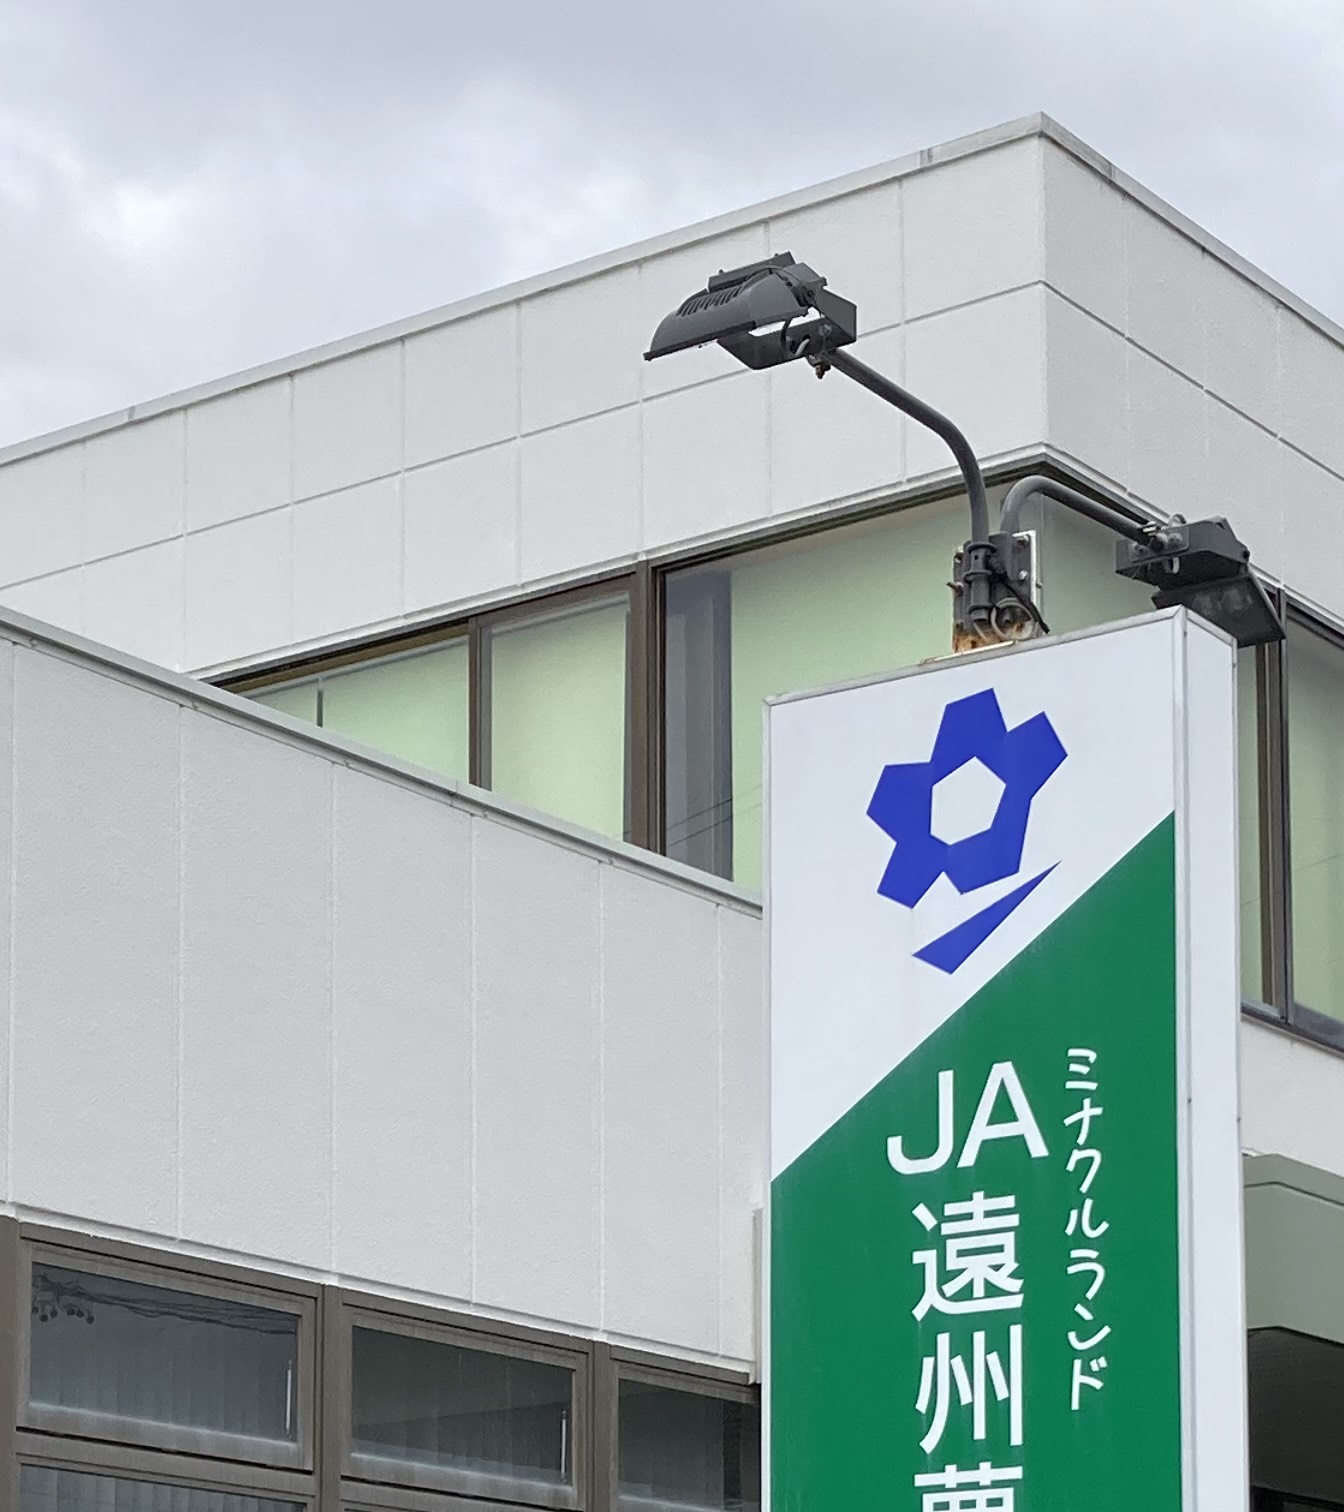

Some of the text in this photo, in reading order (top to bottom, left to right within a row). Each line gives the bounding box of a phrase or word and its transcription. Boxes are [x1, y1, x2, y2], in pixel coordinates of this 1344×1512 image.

[1063, 1047, 1112, 1412] ミナクルランド
